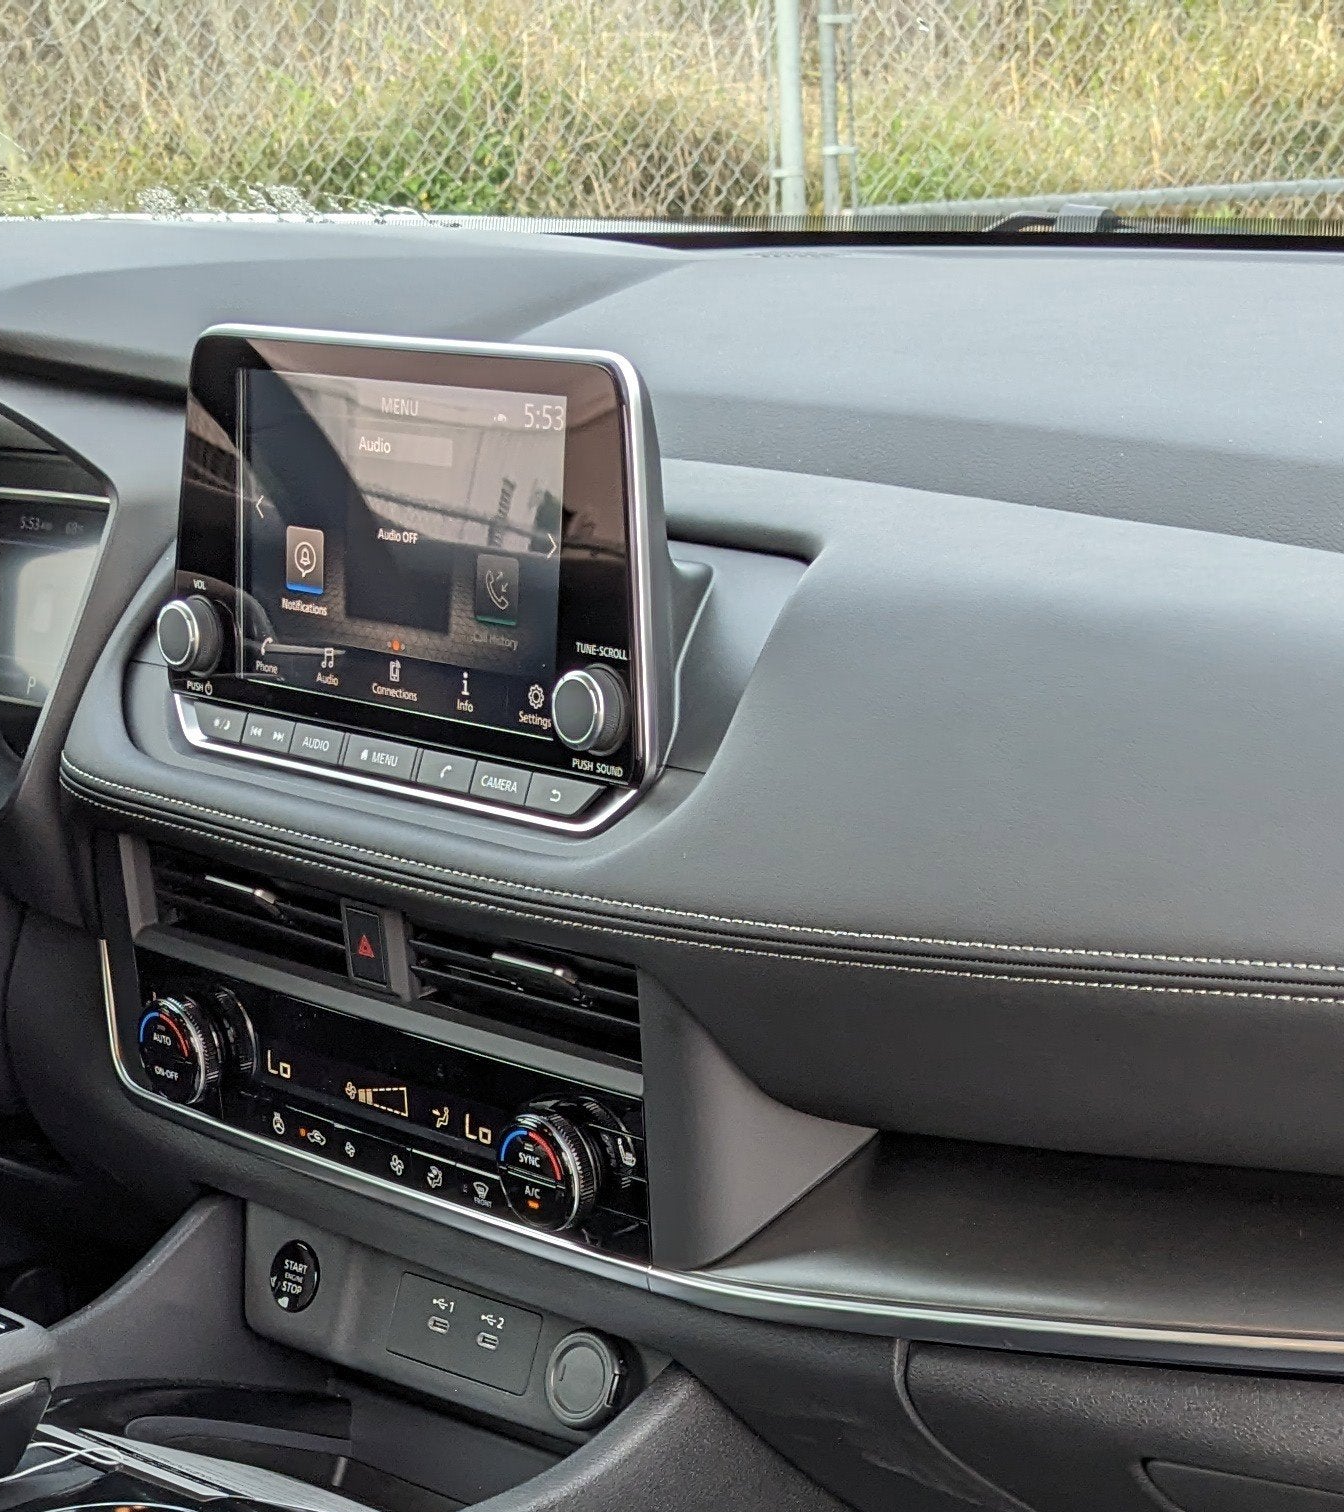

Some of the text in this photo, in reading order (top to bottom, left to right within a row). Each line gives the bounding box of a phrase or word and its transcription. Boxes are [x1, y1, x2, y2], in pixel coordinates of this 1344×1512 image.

[381, 398, 419, 416] MENU
[524, 403, 564, 431] 5:53
[359, 436, 391, 453] Audio
[377, 528, 417, 544] Audio OFF
[193, 579, 206, 590] VOL
[281, 598, 327, 616] Notifications
[489, 635, 518, 650] History
[256, 660, 278, 675] Phone
[27, 677, 36, 695] P
[186, 680, 204, 692] PUSH
[316, 672, 339, 686] Audio
[372, 683, 418, 701] Connections
[457, 700, 473, 713] Info
[519, 711, 551, 730] Settings
[302, 737, 330, 751] AUDIO
[372, 752, 398, 767] MENU
[572, 758, 623, 777] PUSH SOUND
[481, 775, 517, 793] CAMERA
[153, 1033, 171, 1046] AUTO
[519, 1152, 541, 1168] SYNC
[524, 1186, 541, 1199] A/C
[474, 1196, 492, 1208] FRONT
[284, 1259, 308, 1275] START
[285, 1272, 303, 1282] ENGINE
[282, 1281, 303, 1295] STOP
[497, 1317, 505, 1330] 2
